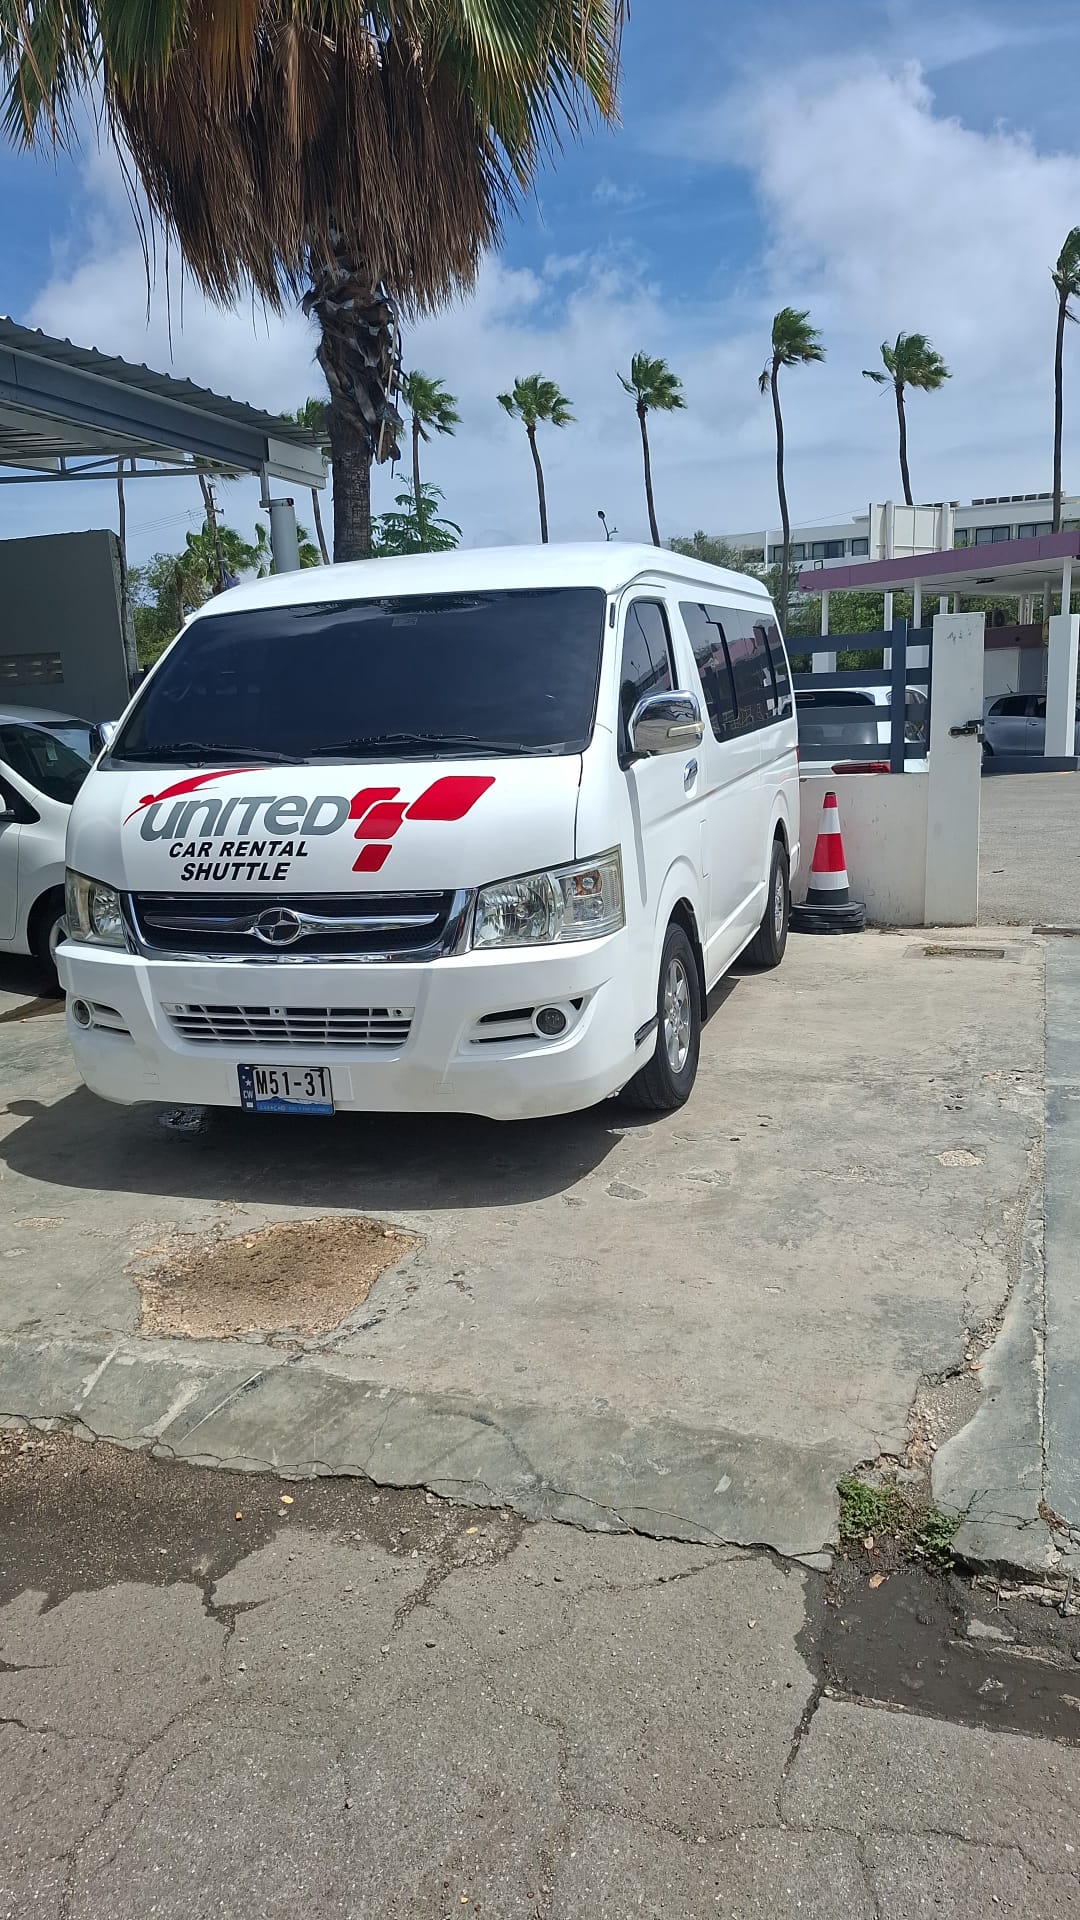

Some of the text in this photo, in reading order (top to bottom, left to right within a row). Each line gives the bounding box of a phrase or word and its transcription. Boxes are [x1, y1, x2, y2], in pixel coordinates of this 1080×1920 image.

[169, 841, 308, 858] CAR RENTAL
[180, 862, 290, 881] SHUTTLE
[256, 1069, 325, 1097] M51-31
[243, 1090, 254, 1099] CW
